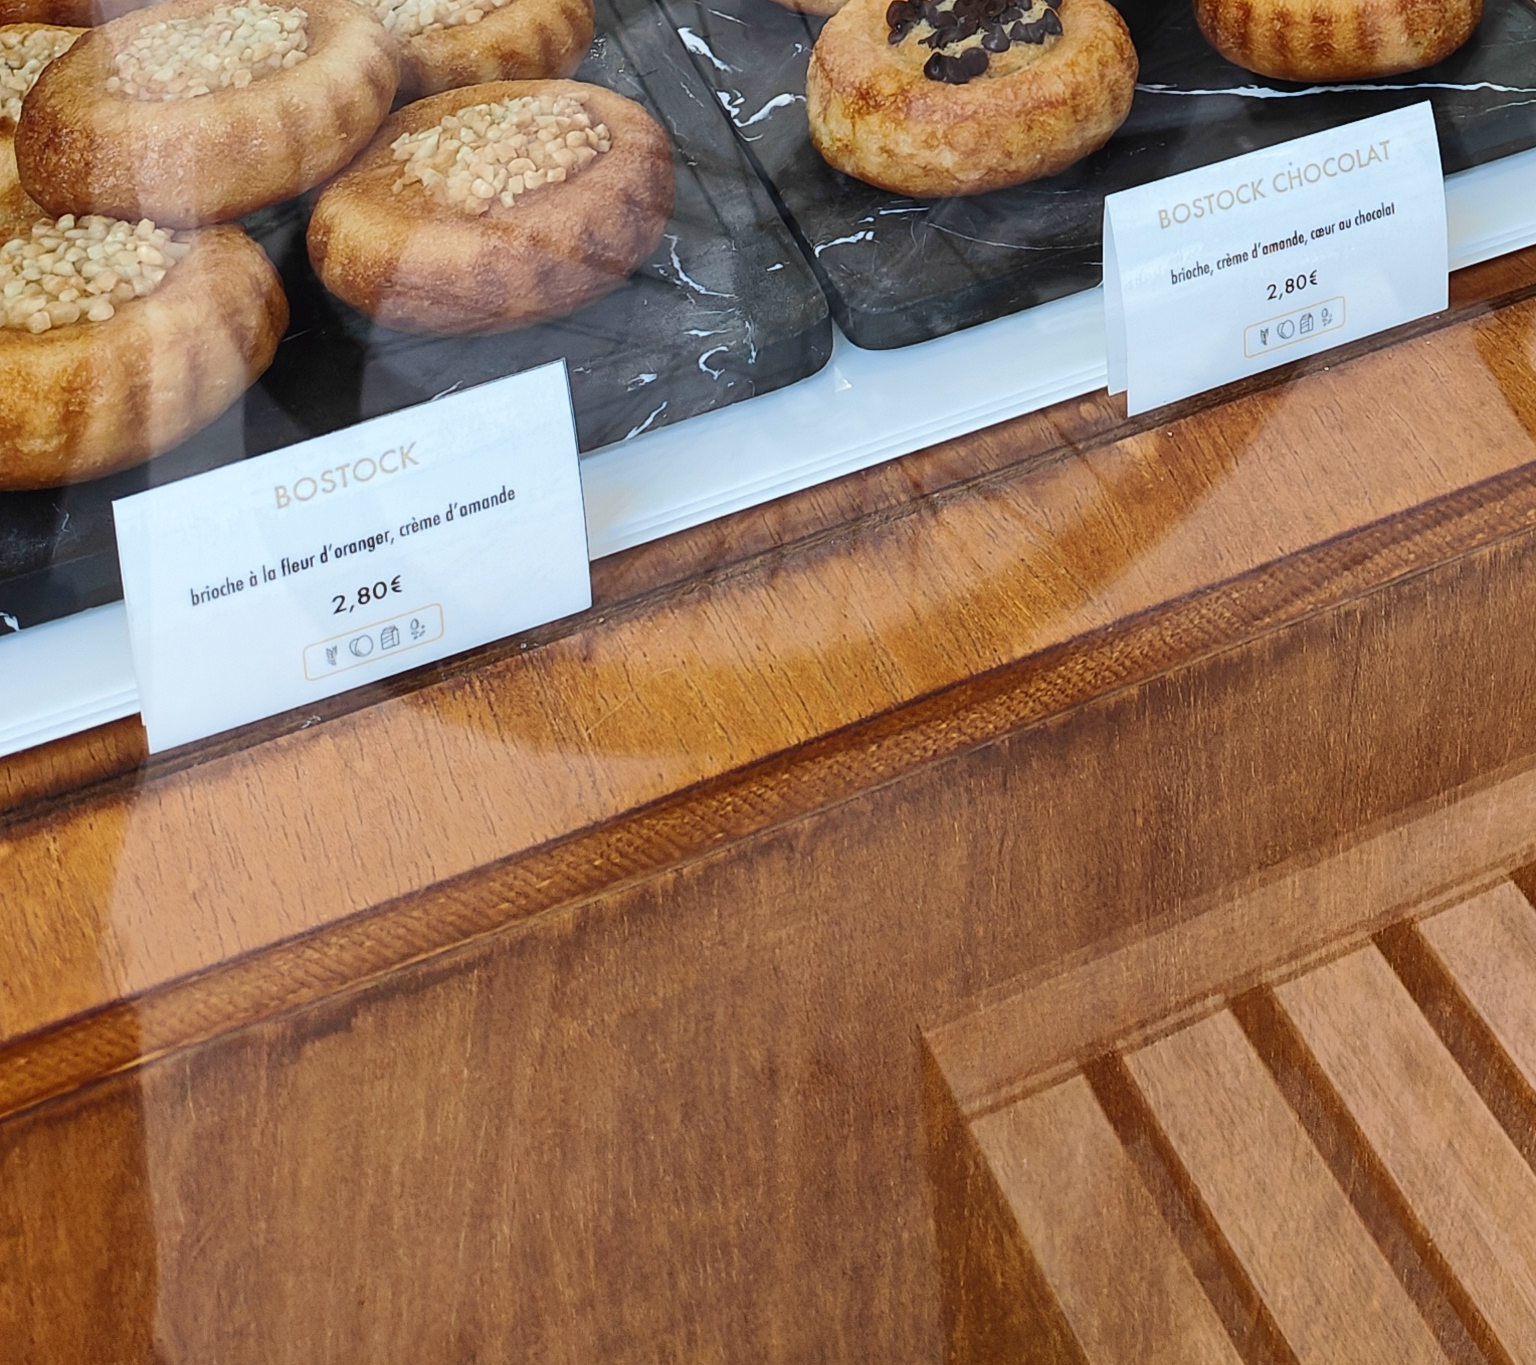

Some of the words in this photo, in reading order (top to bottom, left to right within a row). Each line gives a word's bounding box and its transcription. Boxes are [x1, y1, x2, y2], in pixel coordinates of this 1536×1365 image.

[1158, 179, 1267, 229] BOSTOCK
[1272, 140, 1392, 194] CHOCOLAT
[1171, 263, 1214, 285] brioche,
[1216, 251, 1249, 271] crème
[1251, 230, 1308, 259] d'amande,
[1310, 223, 1336, 241] cœur
[1339, 218, 1352, 231] au
[1354, 202, 1396, 226] chocolat
[1266, 269, 1319, 300] 2,80€
[274, 441, 420, 510] BOSTOCK
[190, 578, 245, 607] brioche
[249, 570, 258, 588] à
[262, 565, 277, 584] la
[281, 551, 315, 577] fleur
[319, 528, 396, 565] d'oranger,
[399, 511, 441, 538] crème
[445, 486, 517, 523] d'amande
[331, 574, 404, 616] 2,80€
